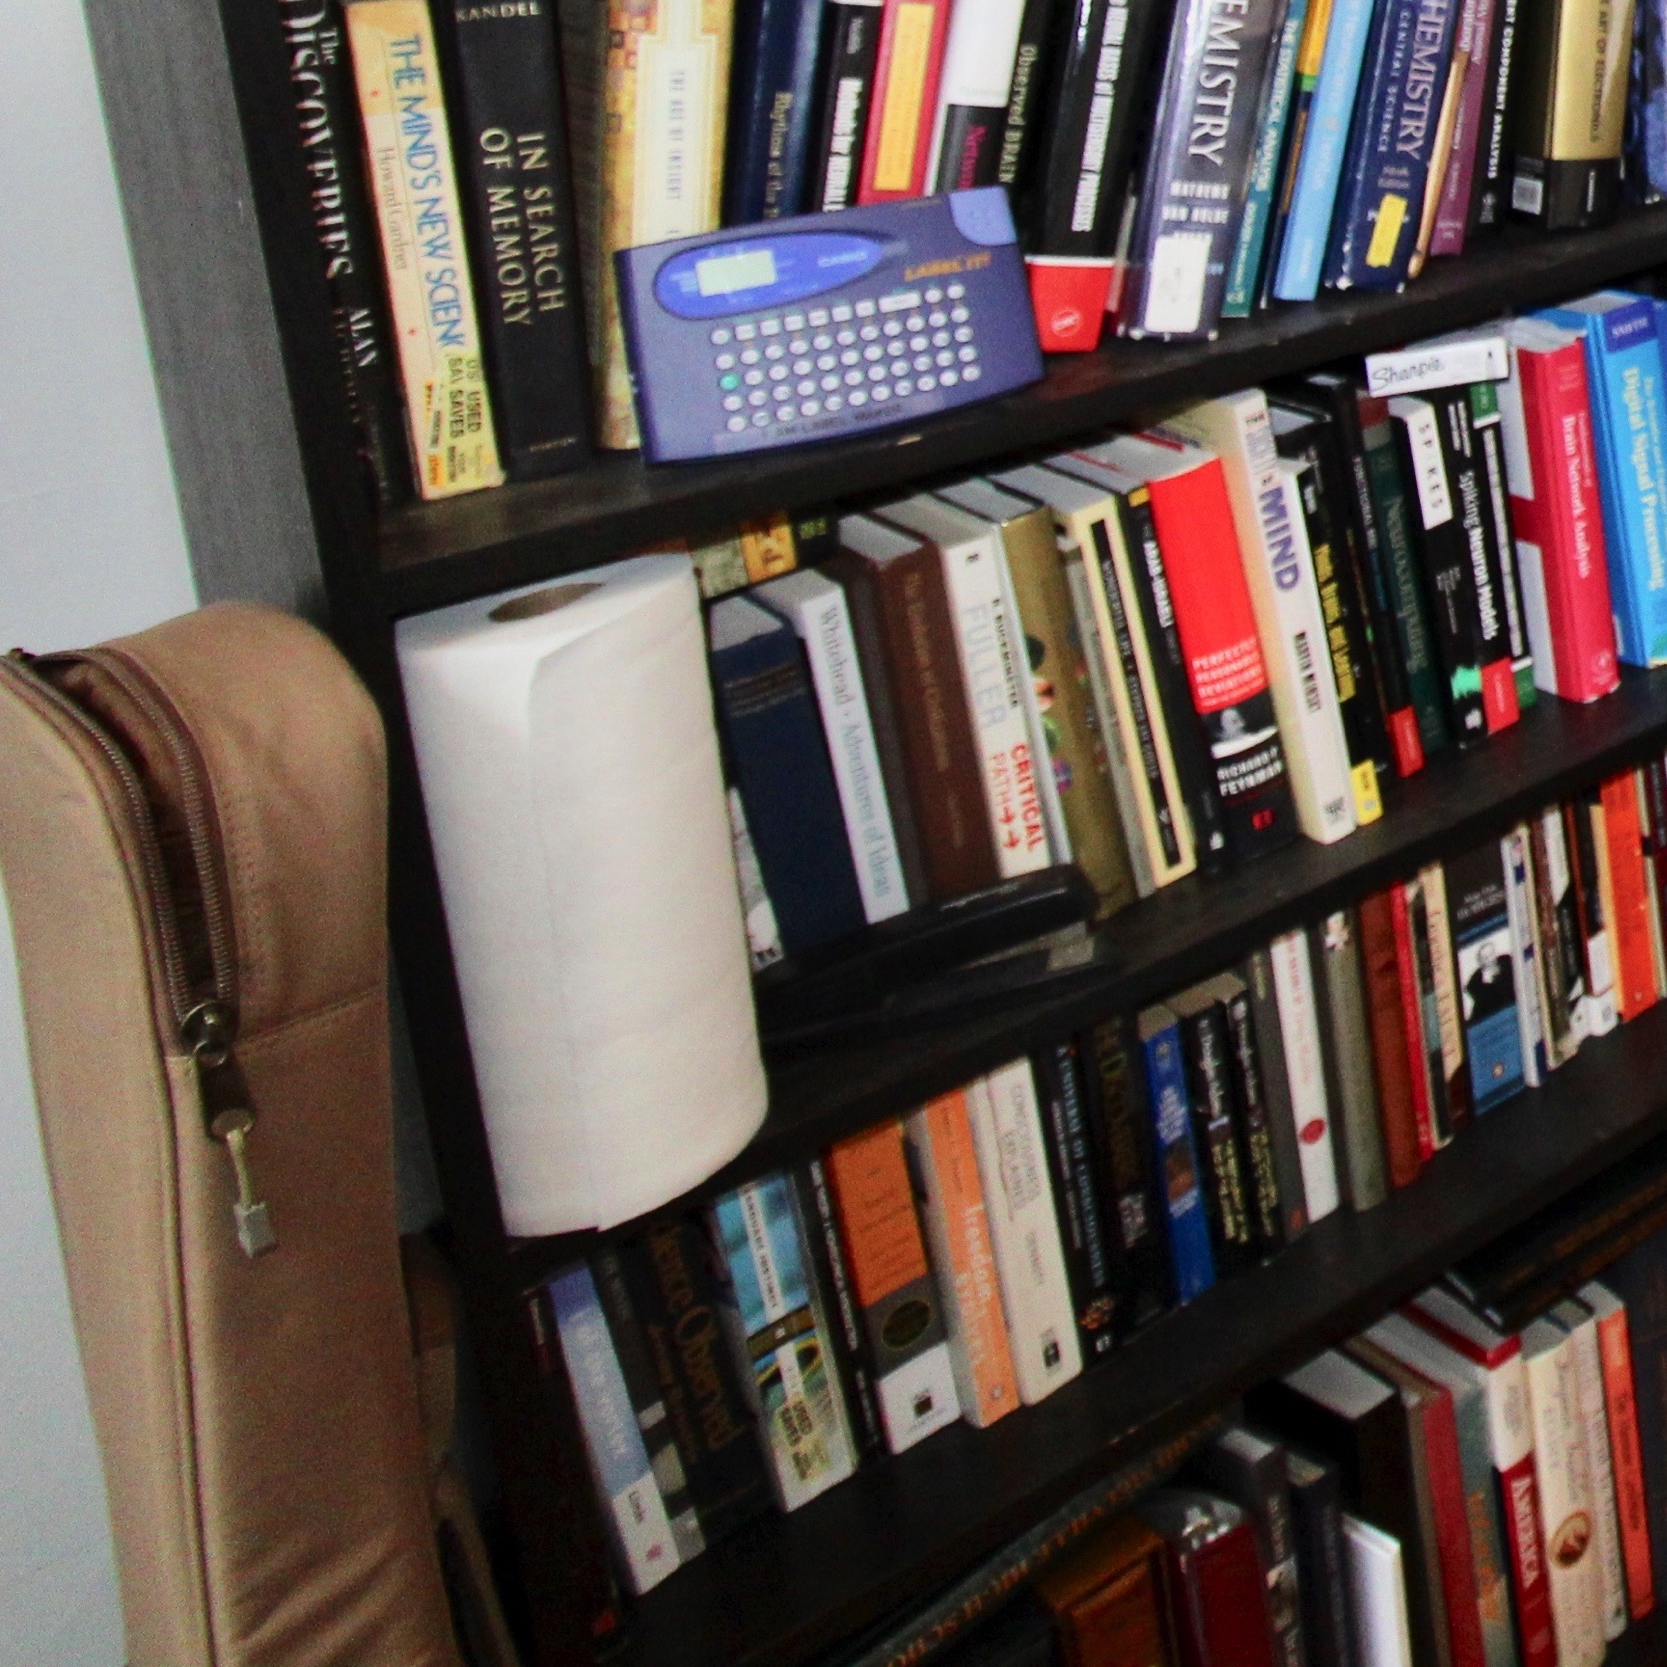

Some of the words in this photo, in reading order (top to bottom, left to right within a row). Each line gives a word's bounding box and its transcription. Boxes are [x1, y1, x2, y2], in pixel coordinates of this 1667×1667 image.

[317, 26, 341, 65] The
[389, 33, 428, 91] THE
[1281, 18, 1299, 43] THE
[1389, 10, 1411, 77] CENTRAL
[1007, 43, 1039, 126] Observed
[1265, 47, 1295, 124] STATISTICAL
[1495, 26, 1514, 110] COMPONENT
[397, 93, 442, 191] MIND'S
[477, 125, 514, 172] OF
[1376, 83, 1398, 152] SCIENCE
[1487, 114, 1504, 178] ANALYSIS
[376, 145, 403, 207] Howard
[516, 130, 550, 171] IN
[997, 128, 1021, 183] BRAIN
[385, 208, 411, 271] Gardner
[413, 196, 453, 262] NEW
[477, 183, 541, 329] MEMORY
[515, 183, 575, 312] SEARCH
[348, 304, 378, 368] ALAN
[1371, 355, 1446, 386] Sharpie
[1620, 367, 1646, 430] Digital
[437, 388, 475, 440] SAVES
[458, 389, 490, 433] USED
[1352, 455, 1373, 526] FUNCTIONAL
[1417, 423, 1444, 509] SPIKES
[1628, 432, 1654, 491] Signal
[1454, 469, 1483, 528] Spiking
[1562, 414, 1578, 455] Brain
[1571, 520, 1592, 578] Analysis
[1257, 485, 1301, 591] MIND
[1466, 527, 1492, 585] Neuron
[1639, 494, 1667, 591] Processing
[1381, 495, 1434, 674] Neurocomputing
[1475, 584, 1501, 640] Models
[815, 603, 857, 706] Whitehead
[958, 603, 1008, 728] FULLER
[839, 722, 881, 823] Adventures
[985, 751, 1017, 806] PATH
[1003, 742, 1052, 852] CRITICAL
[1216, 751, 1267, 782] RICHARD
[1219, 759, 1284, 797] FEYNMAN
[861, 826, 886, 847] of
[865, 847, 897, 898] Ideas
[1057, 1058, 1084, 1132] UNIVERSE
[1071, 1138, 1086, 1158] OF
